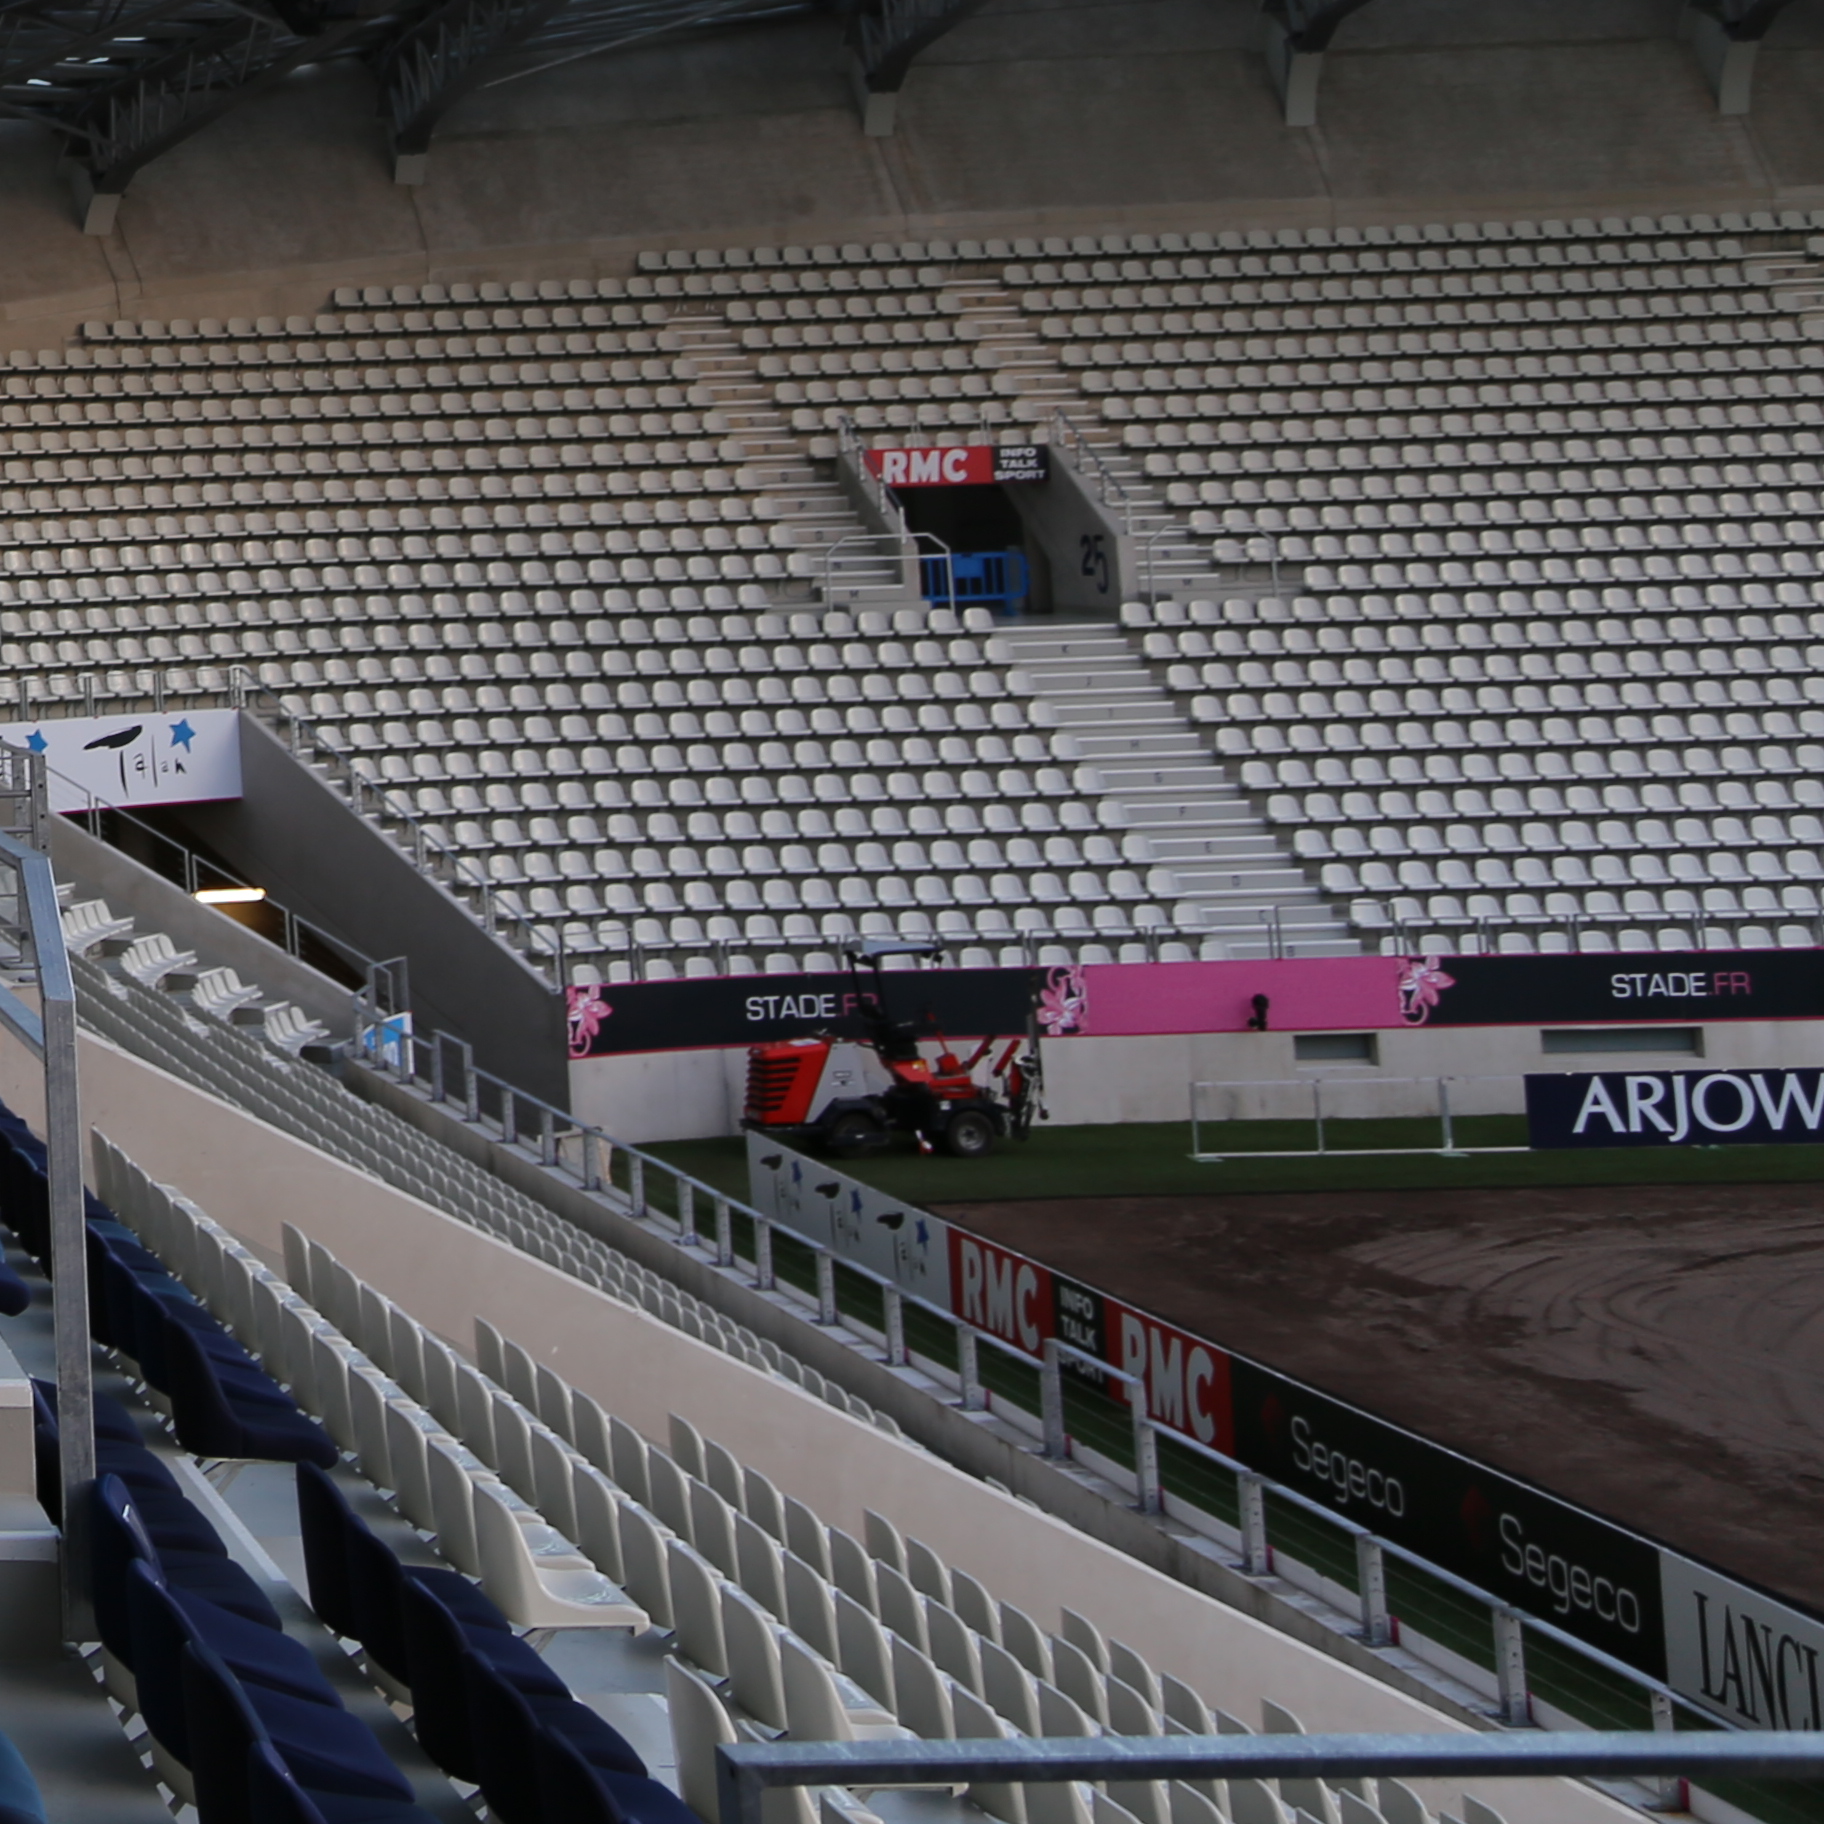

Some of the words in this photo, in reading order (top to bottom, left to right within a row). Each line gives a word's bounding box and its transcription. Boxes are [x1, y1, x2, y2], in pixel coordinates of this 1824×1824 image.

[883, 448, 969, 484] RMC
[1000, 447, 1037, 458] INFO
[1000, 459, 1039, 469] TALK
[994, 469, 1045, 481] SPORT
[1079, 533, 1109, 595] 25
[1611, 971, 1751, 998] STADE.FR
[1572, 1072, 1824, 1143] ARJOW
[960, 1237, 1040, 1352] RMC
[1059, 1285, 1094, 1321] INFO
[1060, 1313, 1097, 1352] TALK
[1121, 1311, 1216, 1444] RMC
[1290, 1415, 1405, 1518] Segeco
[1499, 1513, 1640, 1634] Segeco
